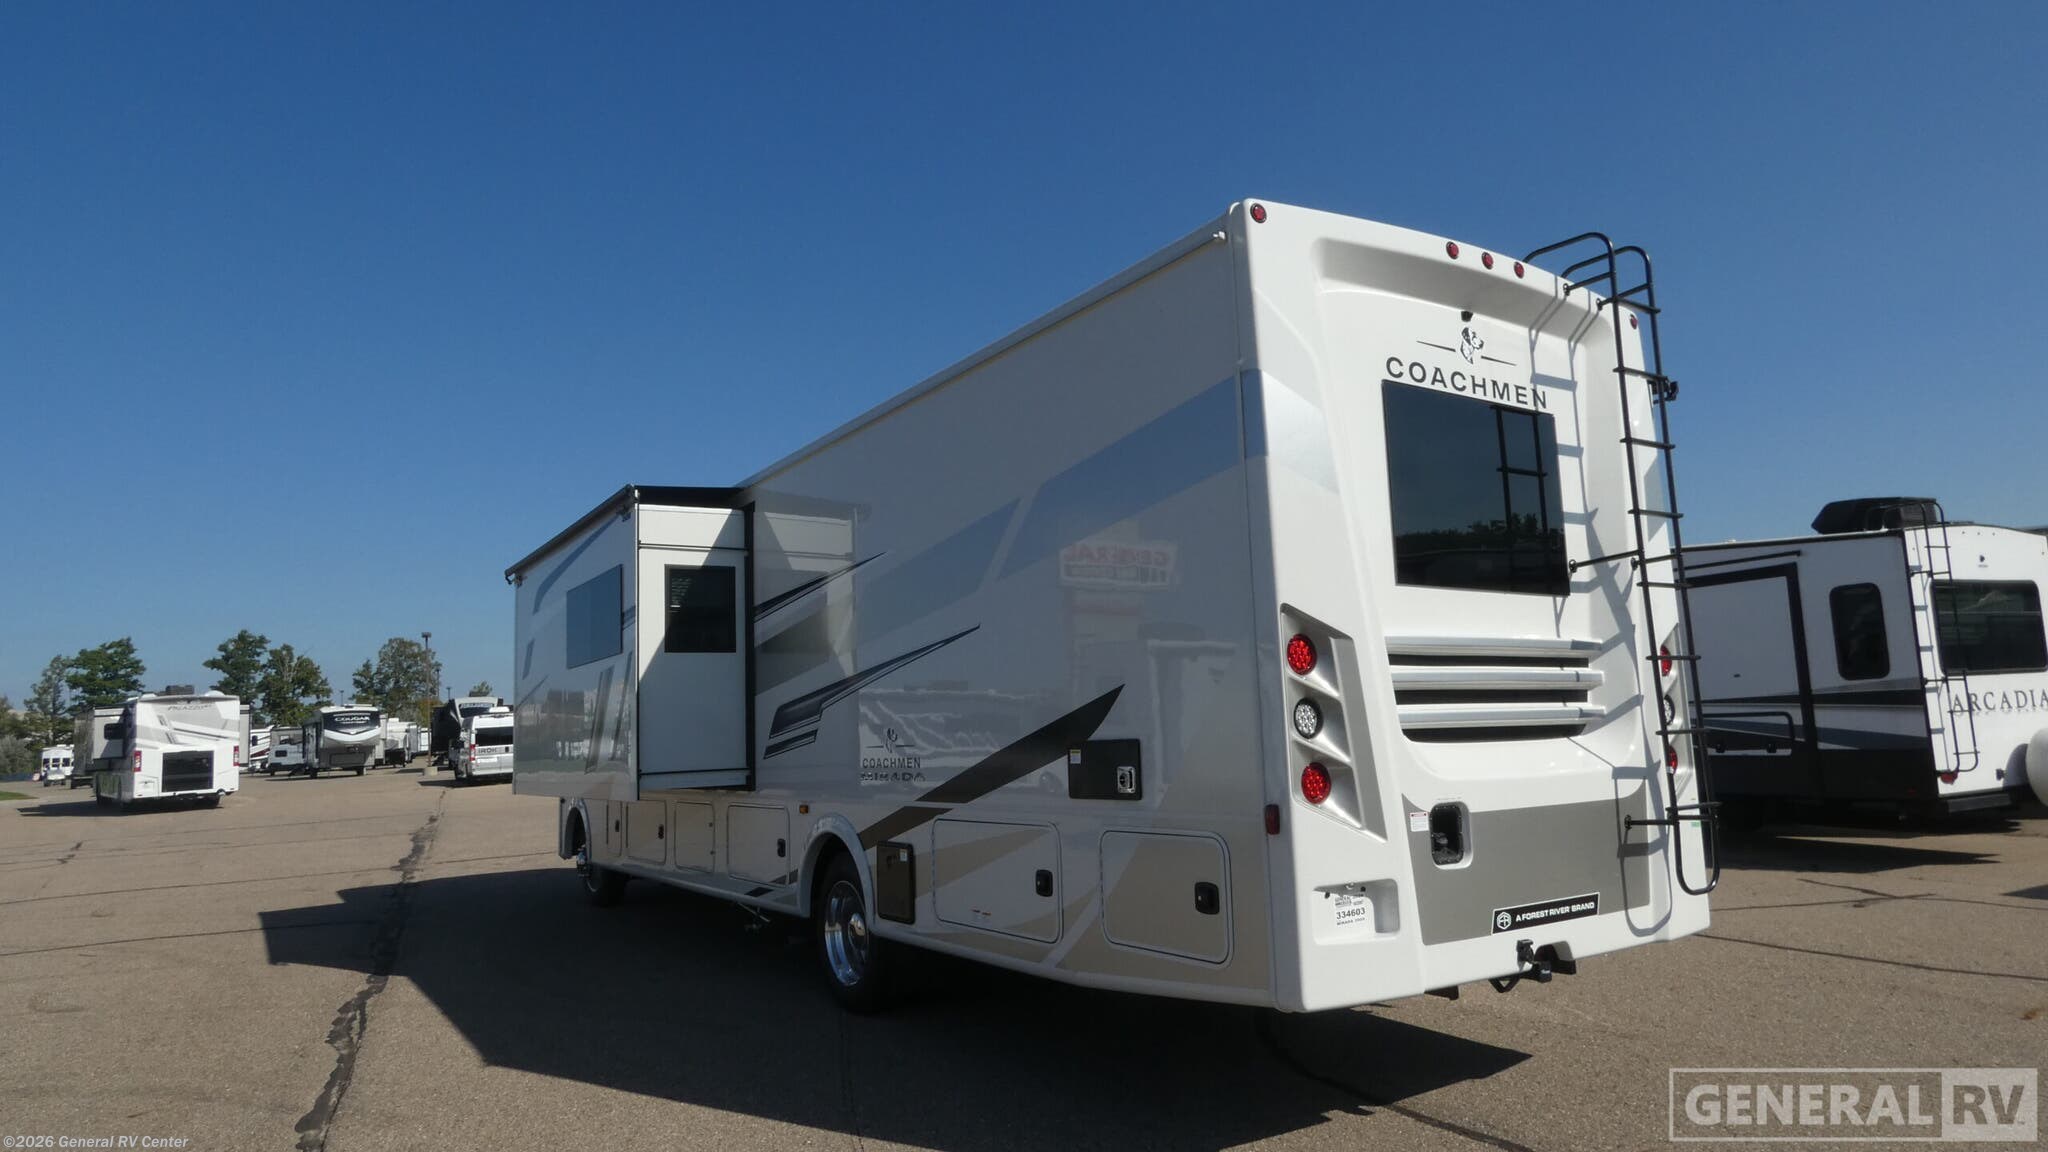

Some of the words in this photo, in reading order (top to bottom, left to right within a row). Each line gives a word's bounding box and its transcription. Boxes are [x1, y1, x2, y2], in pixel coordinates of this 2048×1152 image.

[1386, 356, 1547, 409] COACHMEN
[862, 757, 921, 769] COACHMEN
[1336, 907, 1366, 919] 334603
[1516, 914, 1522, 922] A
[1522, 910, 1549, 921] FOREST
[1549, 905, 1570, 917] RIVER
[1571, 901, 1595, 912] BRAND
